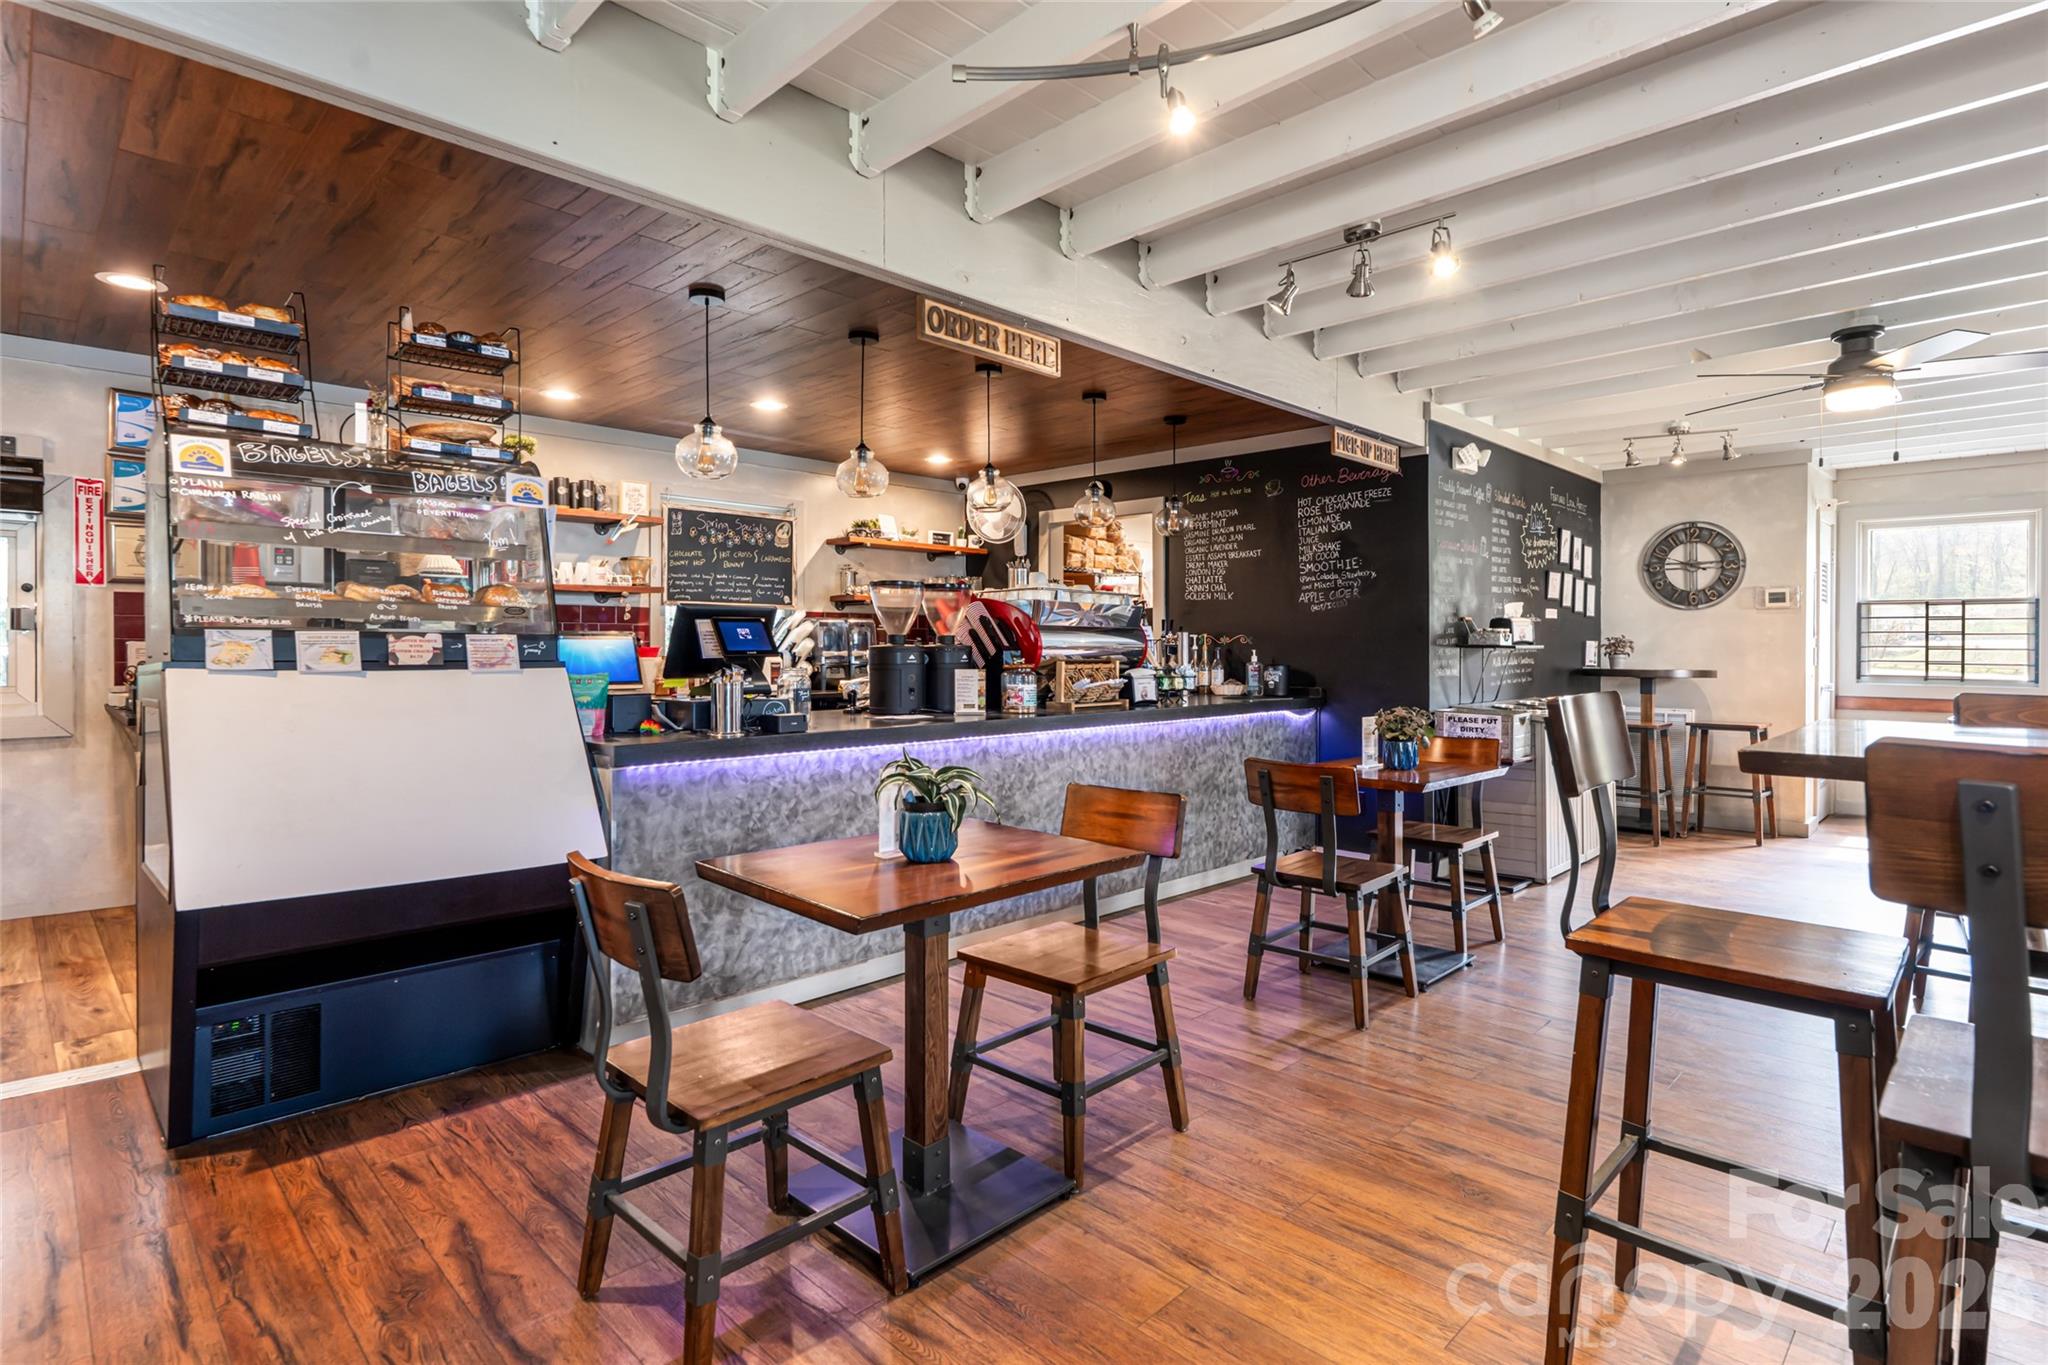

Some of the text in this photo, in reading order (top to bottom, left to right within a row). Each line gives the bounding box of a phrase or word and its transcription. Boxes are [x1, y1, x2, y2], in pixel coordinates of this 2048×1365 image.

[927, 306, 1056, 369] ORDER HERE
[237, 442, 373, 468] BAGELS!
[1337, 432, 1396, 466] PICK-UP HERE
[180, 478, 224, 488] PLAIN
[1300, 468, 1403, 487] Other Beverag
[78, 485, 101, 496] FIRE
[242, 490, 281, 501] RAISIN
[1298, 487, 1392, 507] HOT CHOCOLATE FREEZE
[1183, 492, 1207, 504] Teas
[1211, 508, 1239, 518] MATCHA
[1298, 500, 1371, 518] ROSE LEMONADE
[280, 512, 320, 528] Special
[697, 513, 729, 536] Spring
[1298, 514, 1341, 527] LEMONADE
[1184, 523, 1257, 540] JASMINE DRAGON PEARL
[1299, 521, 1352, 536] ITALIAN SODA
[1687, 527, 1701, 542] 12
[85, 498, 93, 577] EXTINGUISHER
[1184, 533, 1244, 548] ORGANIC MAO JIAN
[1298, 535, 1319, 545] JUICE
[1707, 531, 1718, 544] 1
[1184, 543, 1238, 555] ORGANIC LAVENDER
[1299, 541, 1341, 555] MILKSHAKE
[1653, 545, 1669, 559] 10
[1718, 542, 1734, 555] 2
[1185, 549, 1262, 562] ESTATE ASSAM BREAKFAST
[1299, 551, 1340, 562] HOT COCOA
[723, 561, 745, 569] BUNNY
[1186, 560, 1229, 569] DREAM MAKER
[1299, 557, 1362, 574] SMOOTHIE:
[1722, 559, 1739, 569] 3
[1212, 568, 1226, 576] FOG
[1185, 576, 1202, 585] CHAI
[1314, 581, 1335, 590] Mixed
[1337, 578, 1362, 588] Berry)
[1720, 576, 1734, 587] 4
[1185, 583, 1227, 593] SKINNY CHAI
[1705, 588, 1718, 600] 5
[1184, 592, 1234, 600] GOLDEN MILK
[1298, 588, 1360, 603] APPLE CIDER
[1689, 591, 1699, 605] 6
[193, 615, 225, 623] PLEASE
